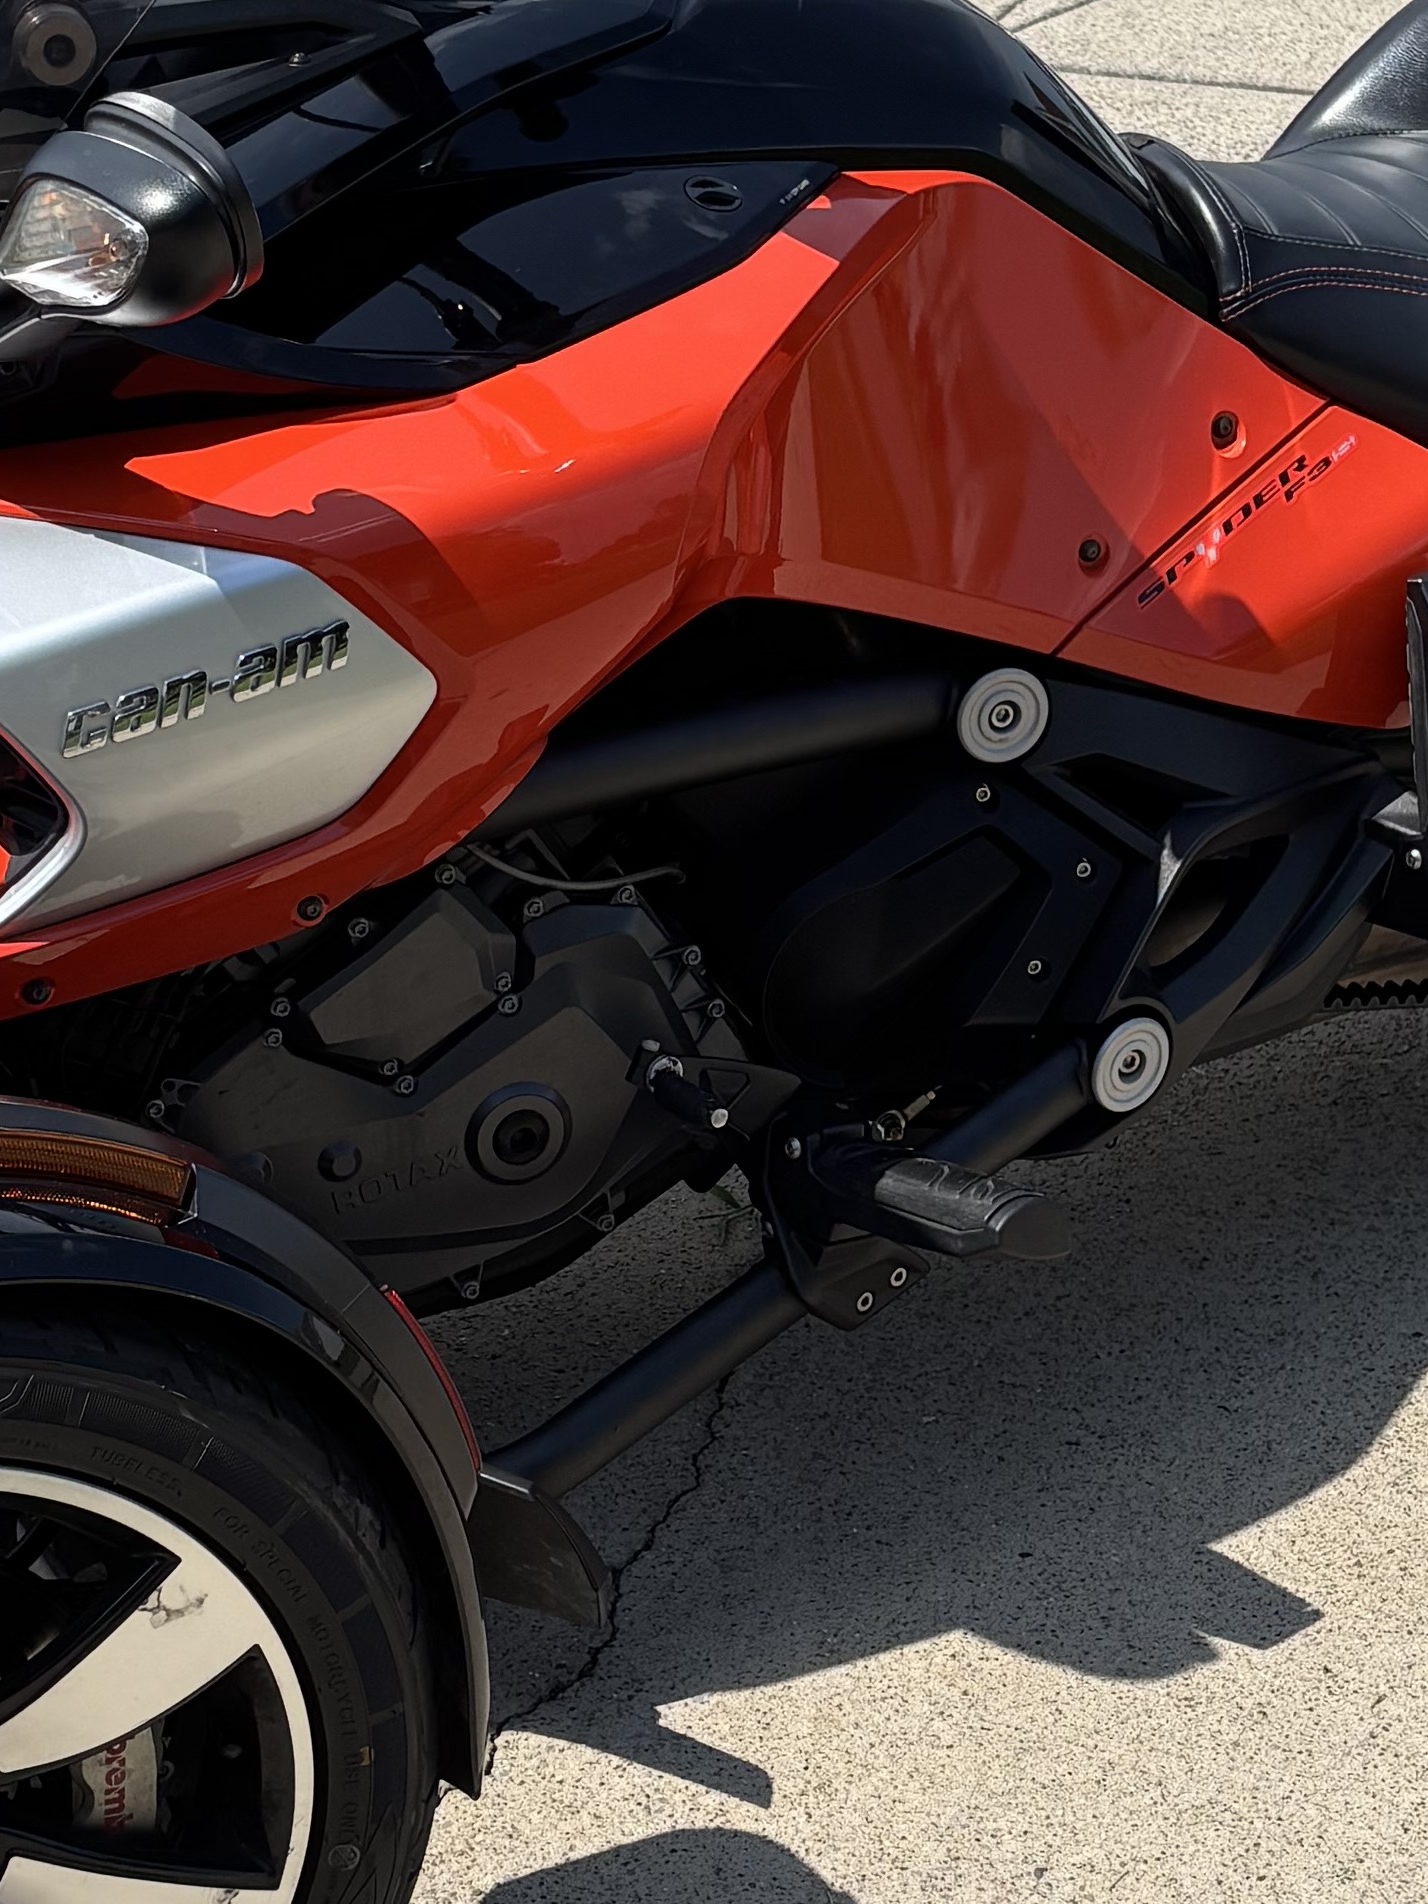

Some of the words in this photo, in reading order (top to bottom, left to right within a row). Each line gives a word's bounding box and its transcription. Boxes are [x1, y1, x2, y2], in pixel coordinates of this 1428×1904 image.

[1137, 454, 1309, 609] SPYDER
[1284, 456, 1332, 503] F3
[61, 619, 350, 760] can-am
[330, 1145, 464, 1216] ROTAX
